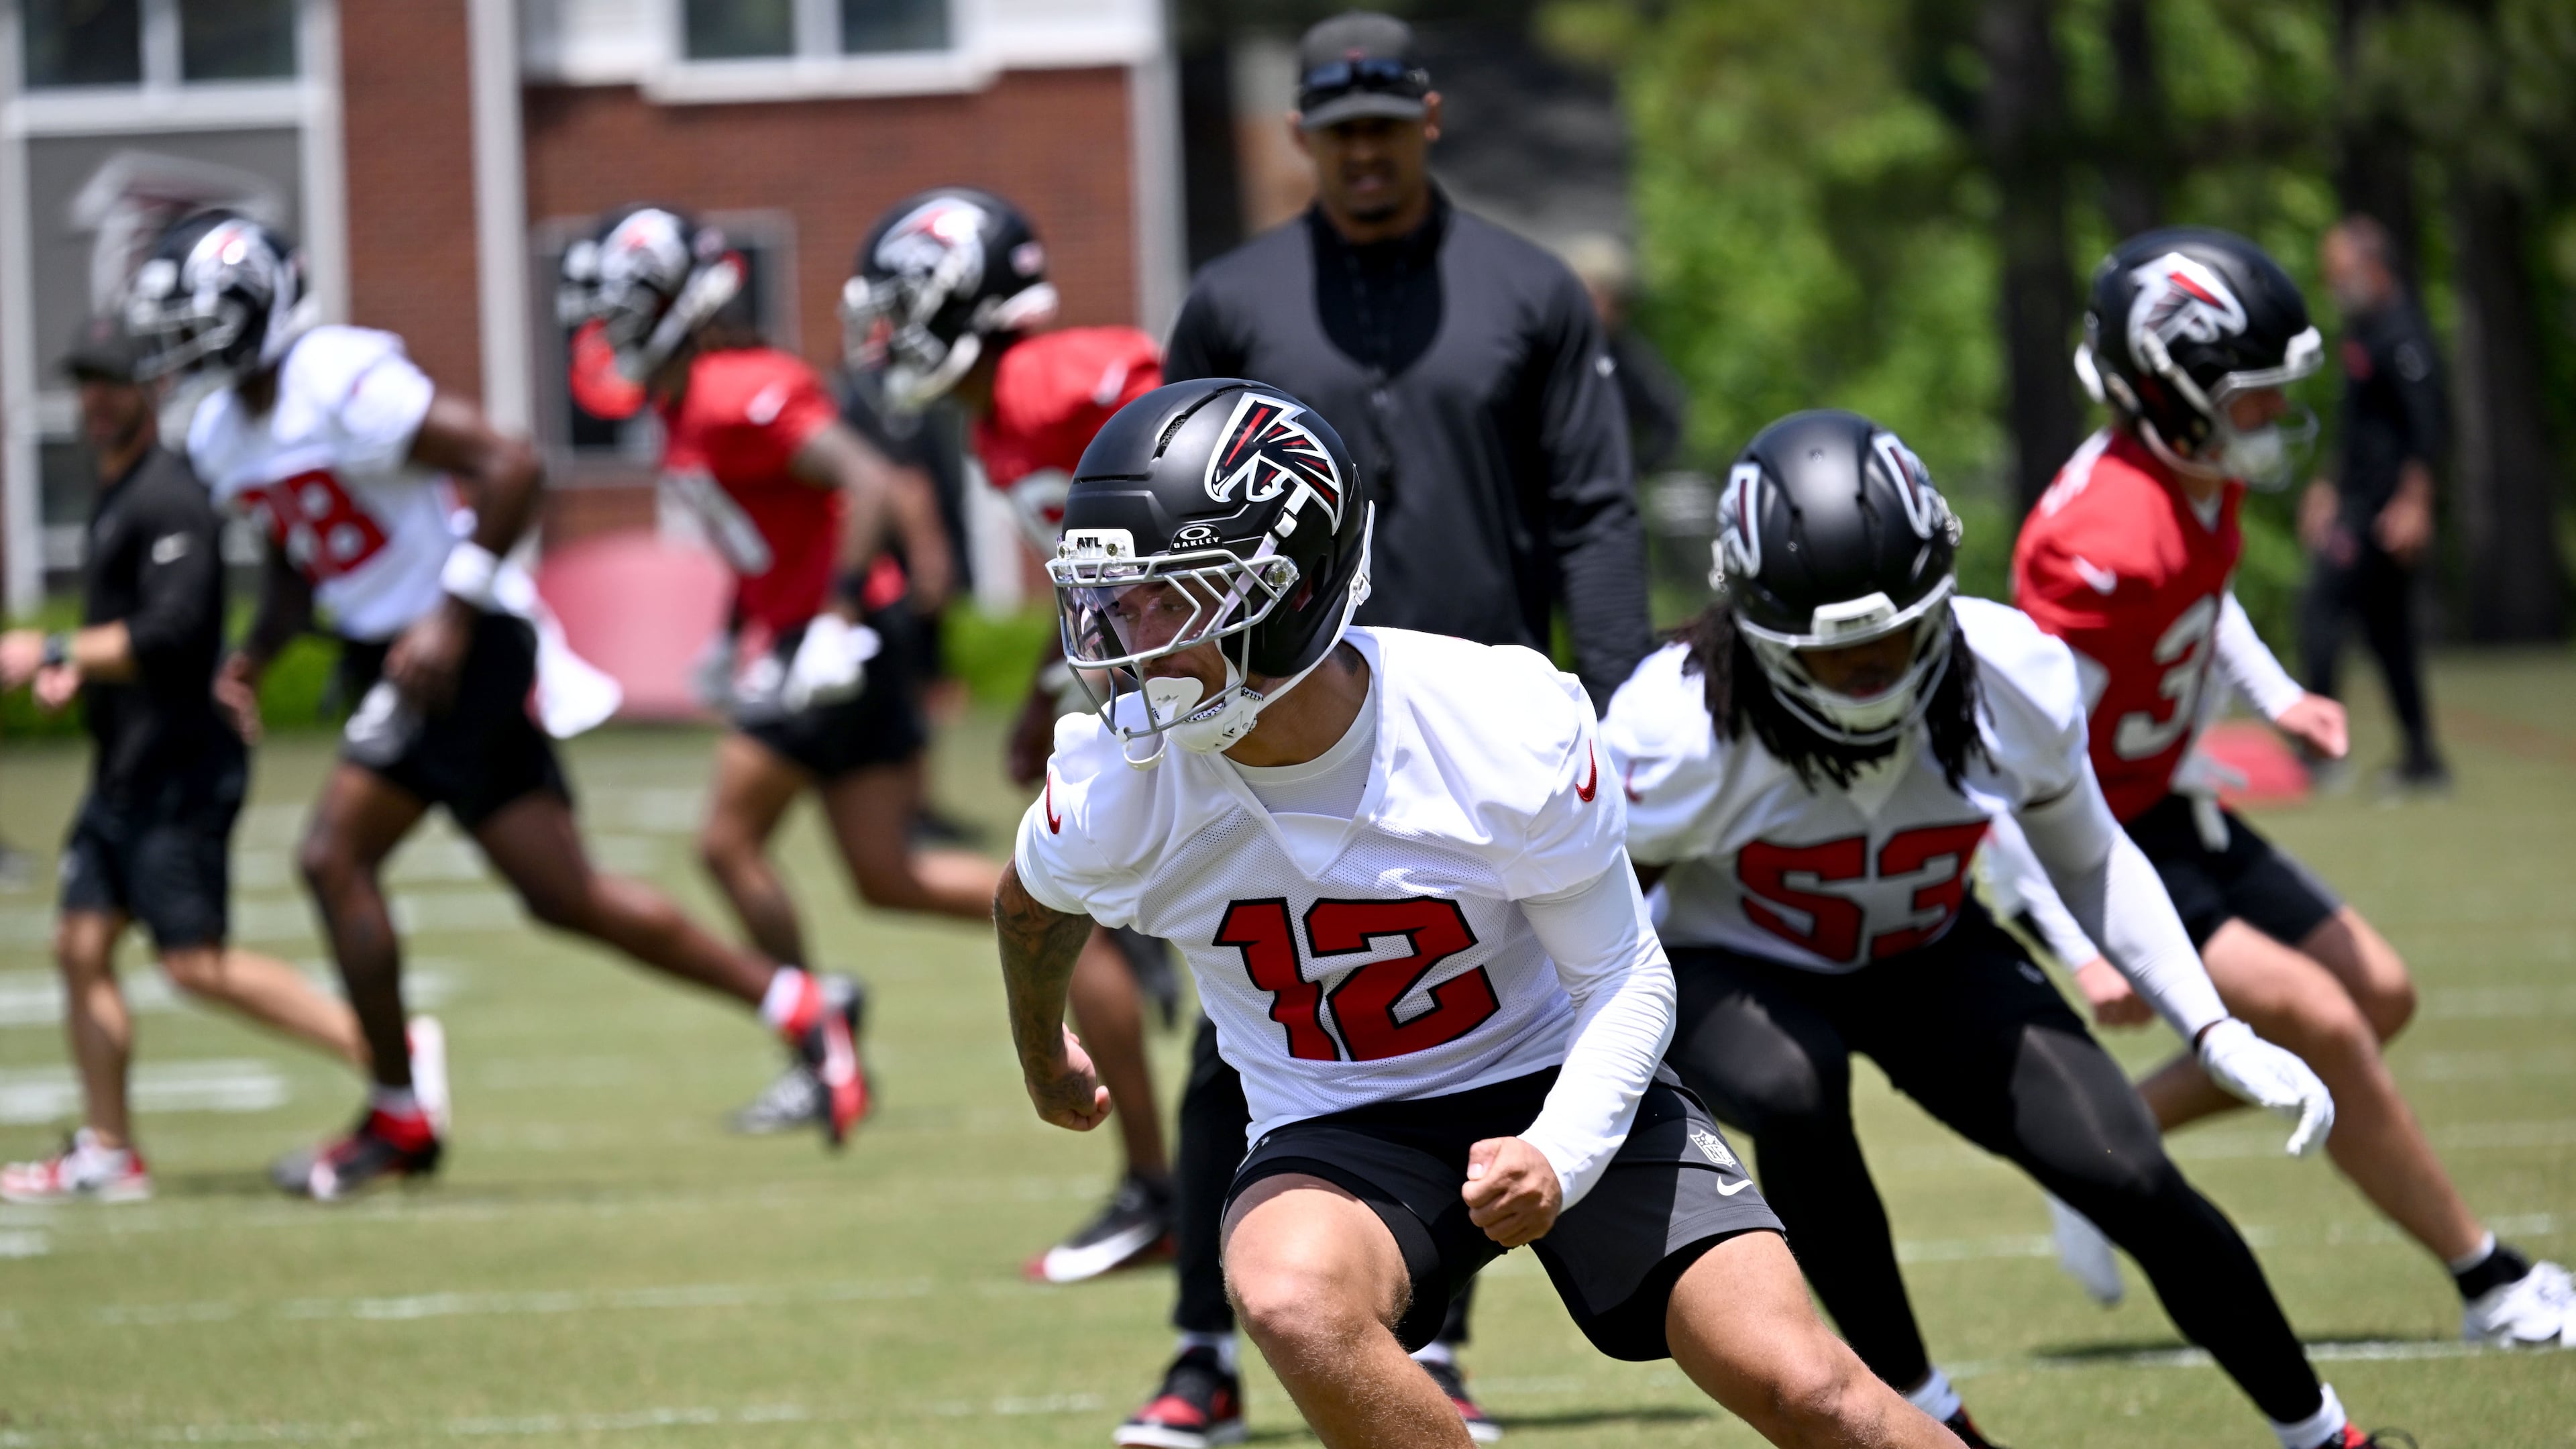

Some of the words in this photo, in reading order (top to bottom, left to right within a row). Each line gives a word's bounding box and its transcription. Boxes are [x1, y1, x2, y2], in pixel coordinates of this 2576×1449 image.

[1077, 537, 1102, 549] ATL
[1173, 536, 1221, 549] OAKLEY
[1736, 819, 1991, 963] 53
[1212, 896, 1501, 1062] 12
